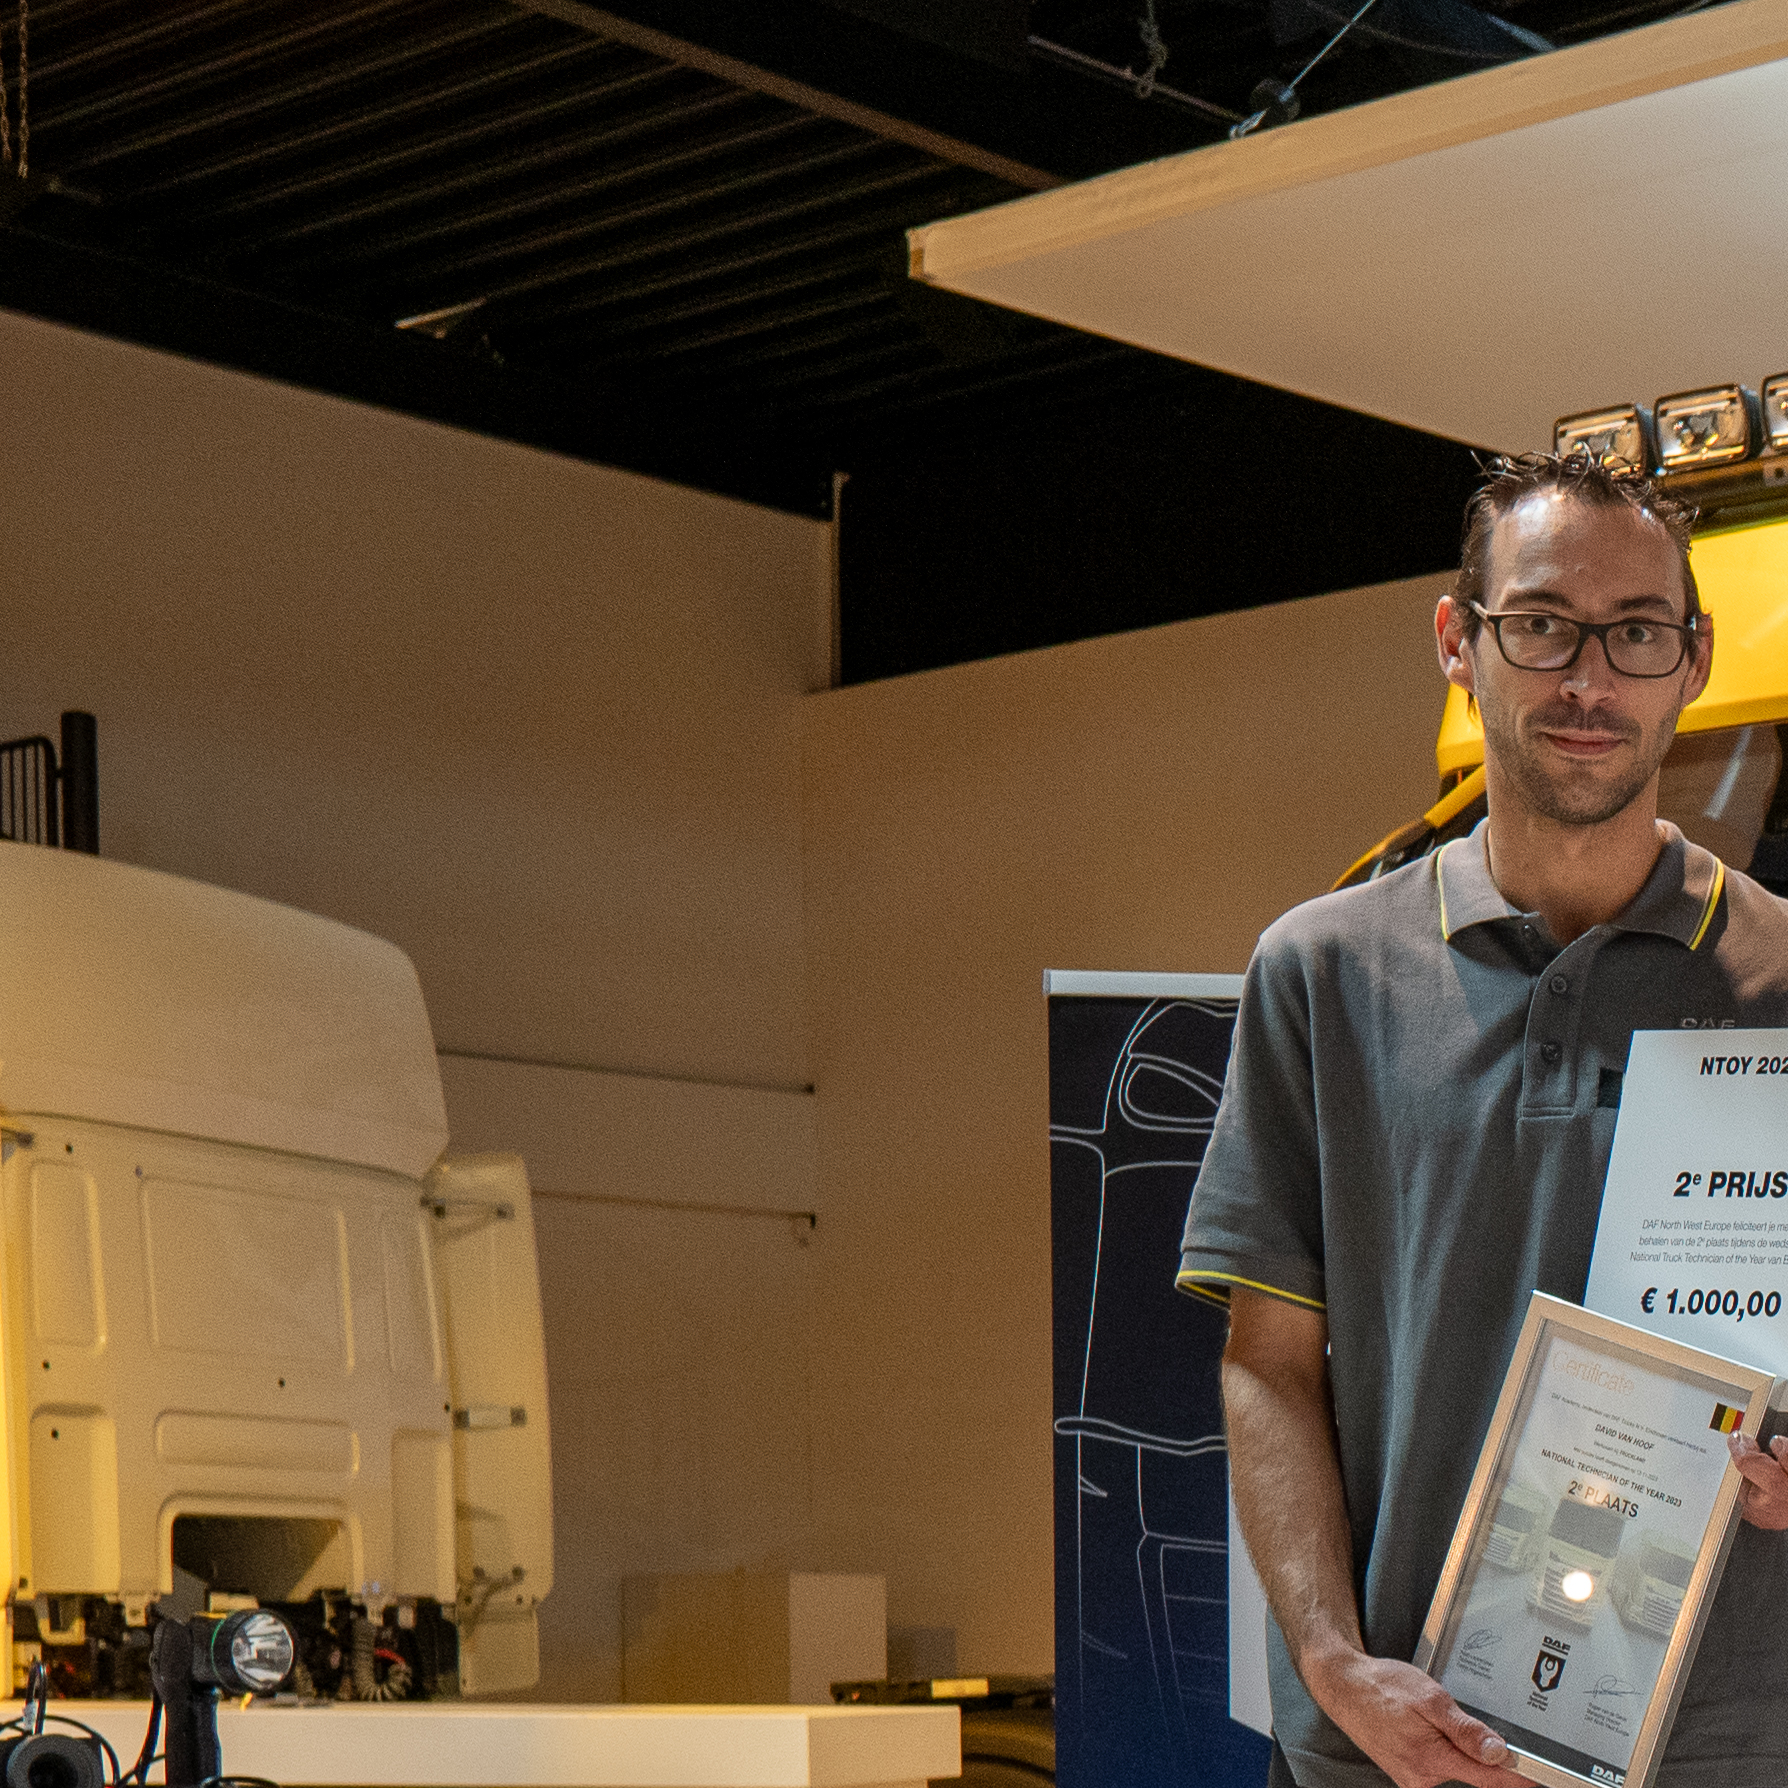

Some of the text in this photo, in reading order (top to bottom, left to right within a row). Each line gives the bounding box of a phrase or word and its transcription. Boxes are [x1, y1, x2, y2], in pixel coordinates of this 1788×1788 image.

[1700, 1056, 1754, 1075] NTOY
[1673, 1171, 1788, 1198] 2e PRIJS
[1642, 1219, 1659, 1230] DAF
[1660, 1220, 1682, 1230] North
[1683, 1220, 1702, 1231] West
[1704, 1220, 1732, 1234] Europe
[1733, 1220, 1767, 1232] feliciteert
[1768, 1222, 1776, 1234] je
[1641, 1287, 1782, 1323] € 1.000,00
[1541, 1449, 1683, 1508] NATIONAL TECHNICIAN OF THE YEAR 2023
[1568, 1480, 1639, 1518] 2e PLAATS
[1544, 1636, 1571, 1650] DAF
[1592, 1764, 1626, 1785] DAF
